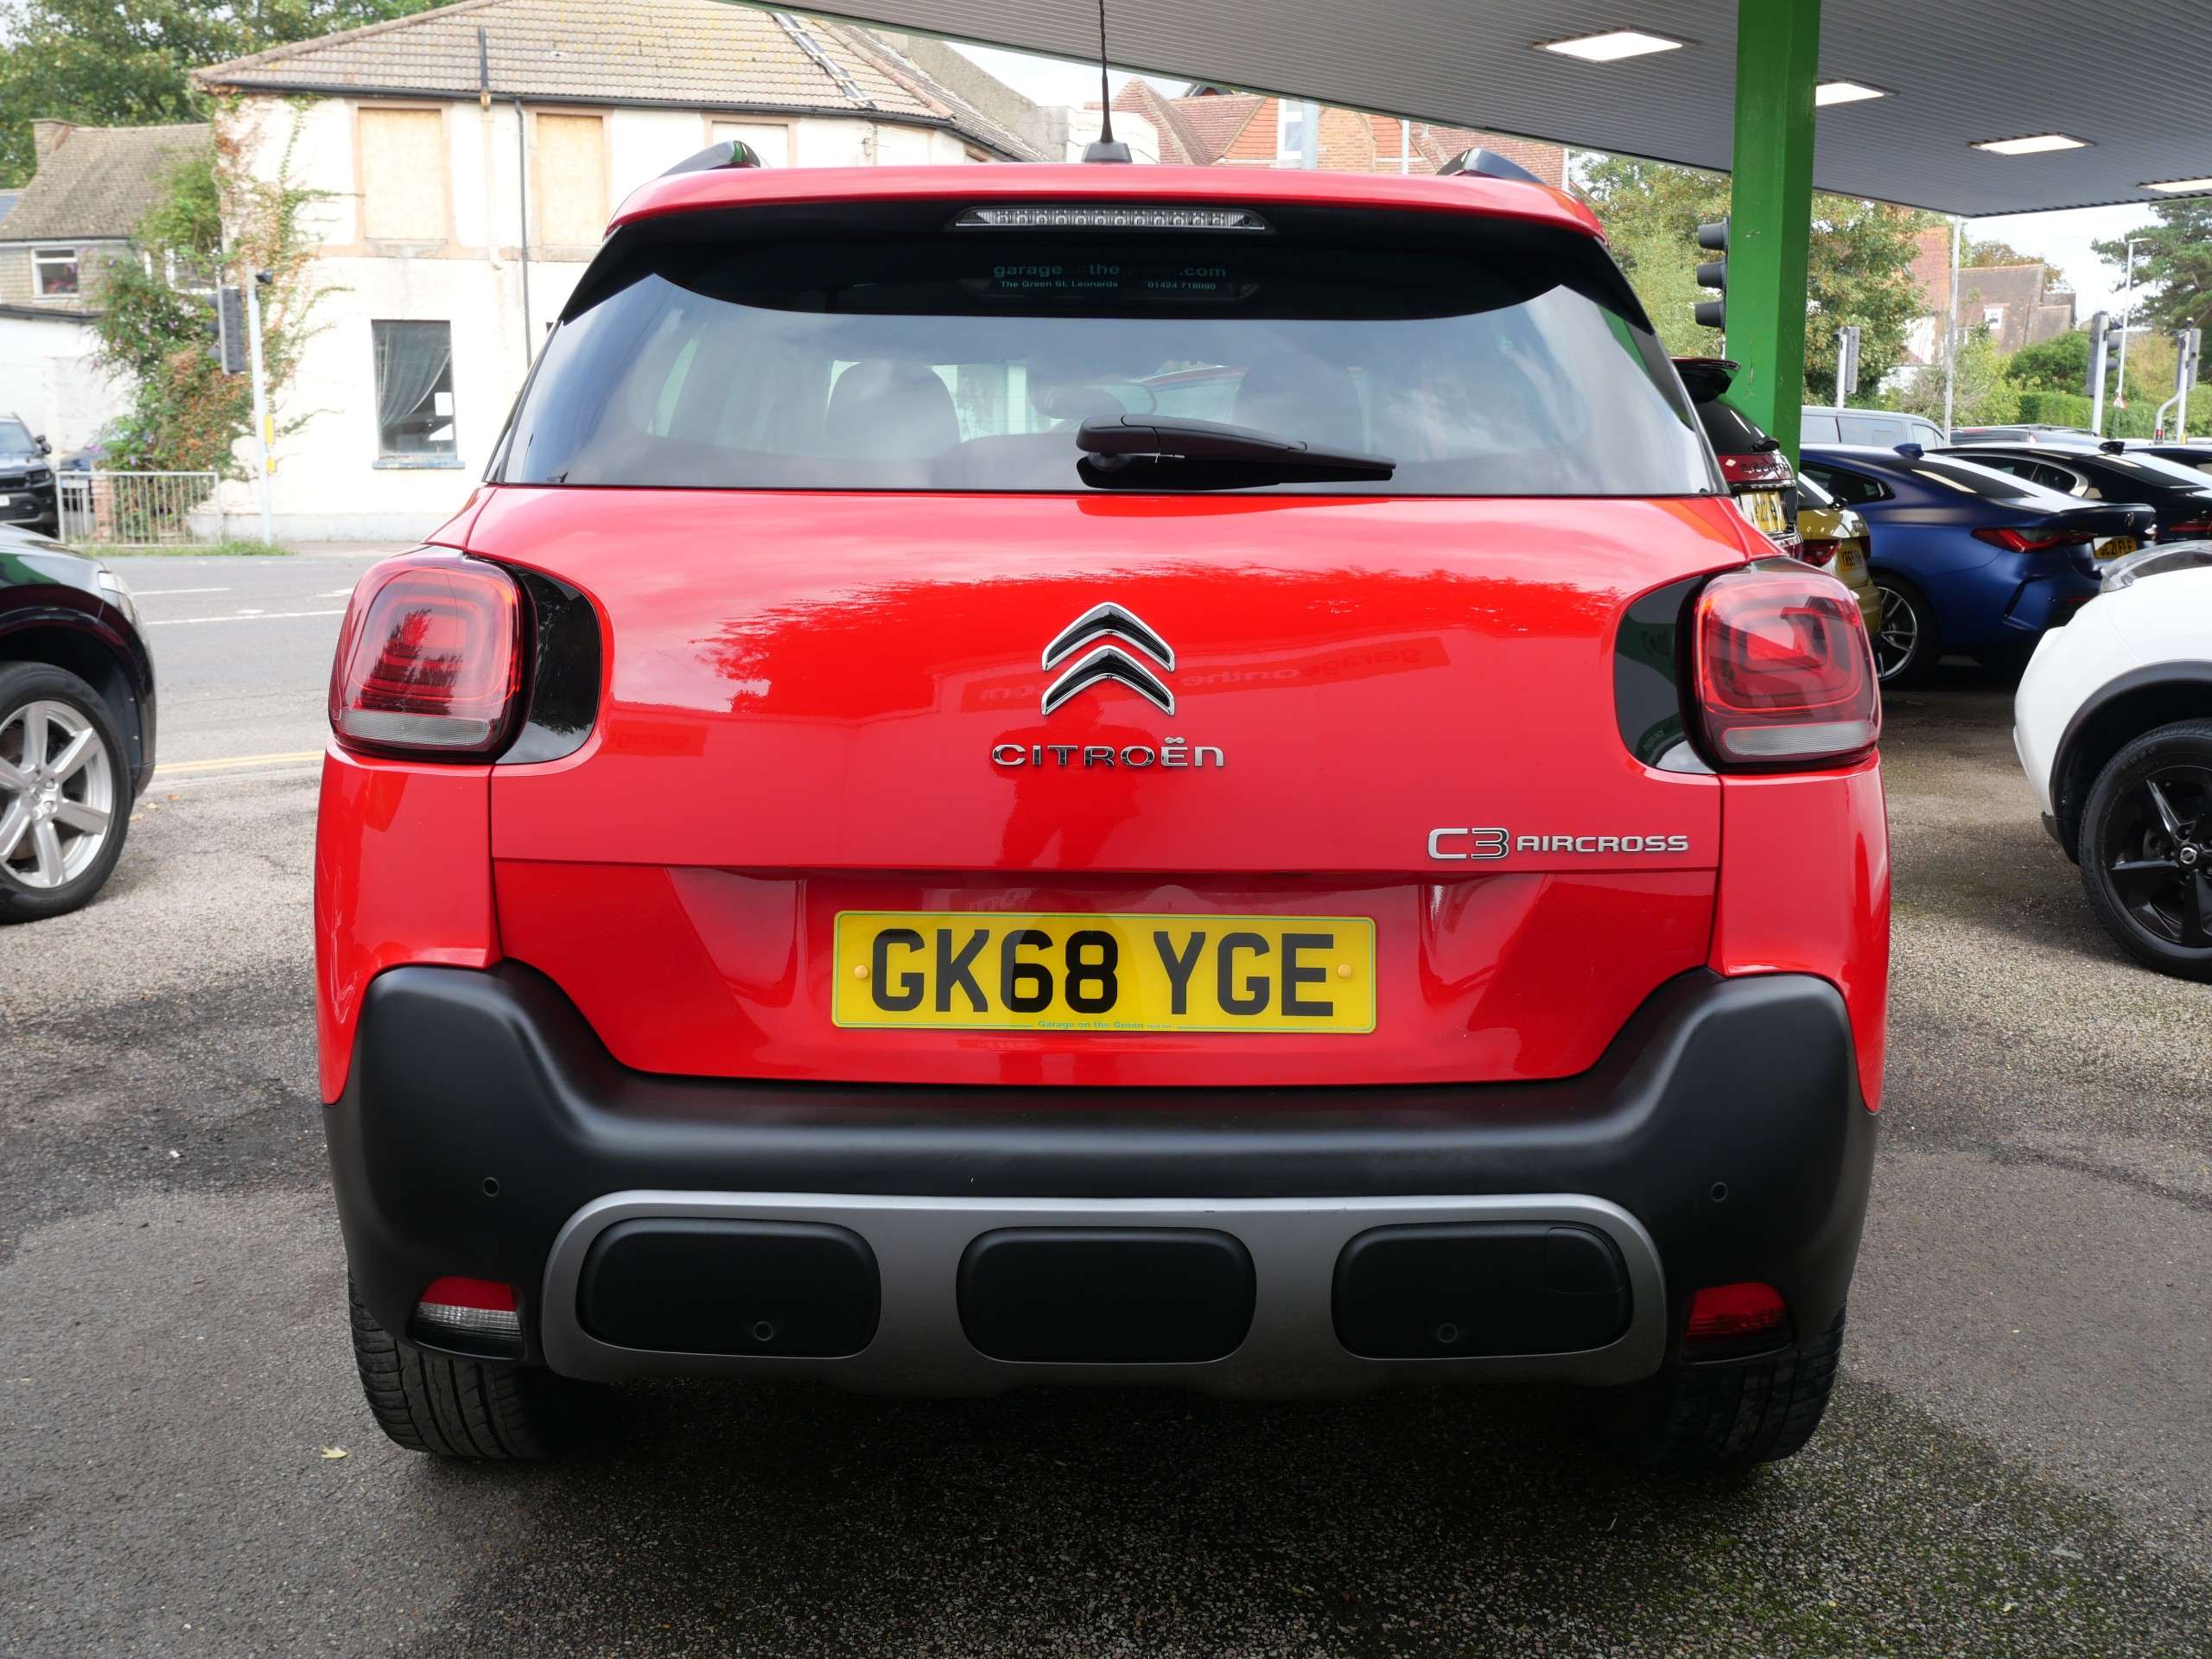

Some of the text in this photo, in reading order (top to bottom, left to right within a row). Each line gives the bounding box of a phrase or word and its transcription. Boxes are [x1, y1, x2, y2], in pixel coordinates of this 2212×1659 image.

[994, 264, 1062, 277] garage
[1089, 263, 1121, 276] the
[1427, 827, 1690, 860] C3 AIRCROSS
[871, 927, 1334, 1017] GK68 YGE
[1037, 1020, 1075, 1030] Garage
